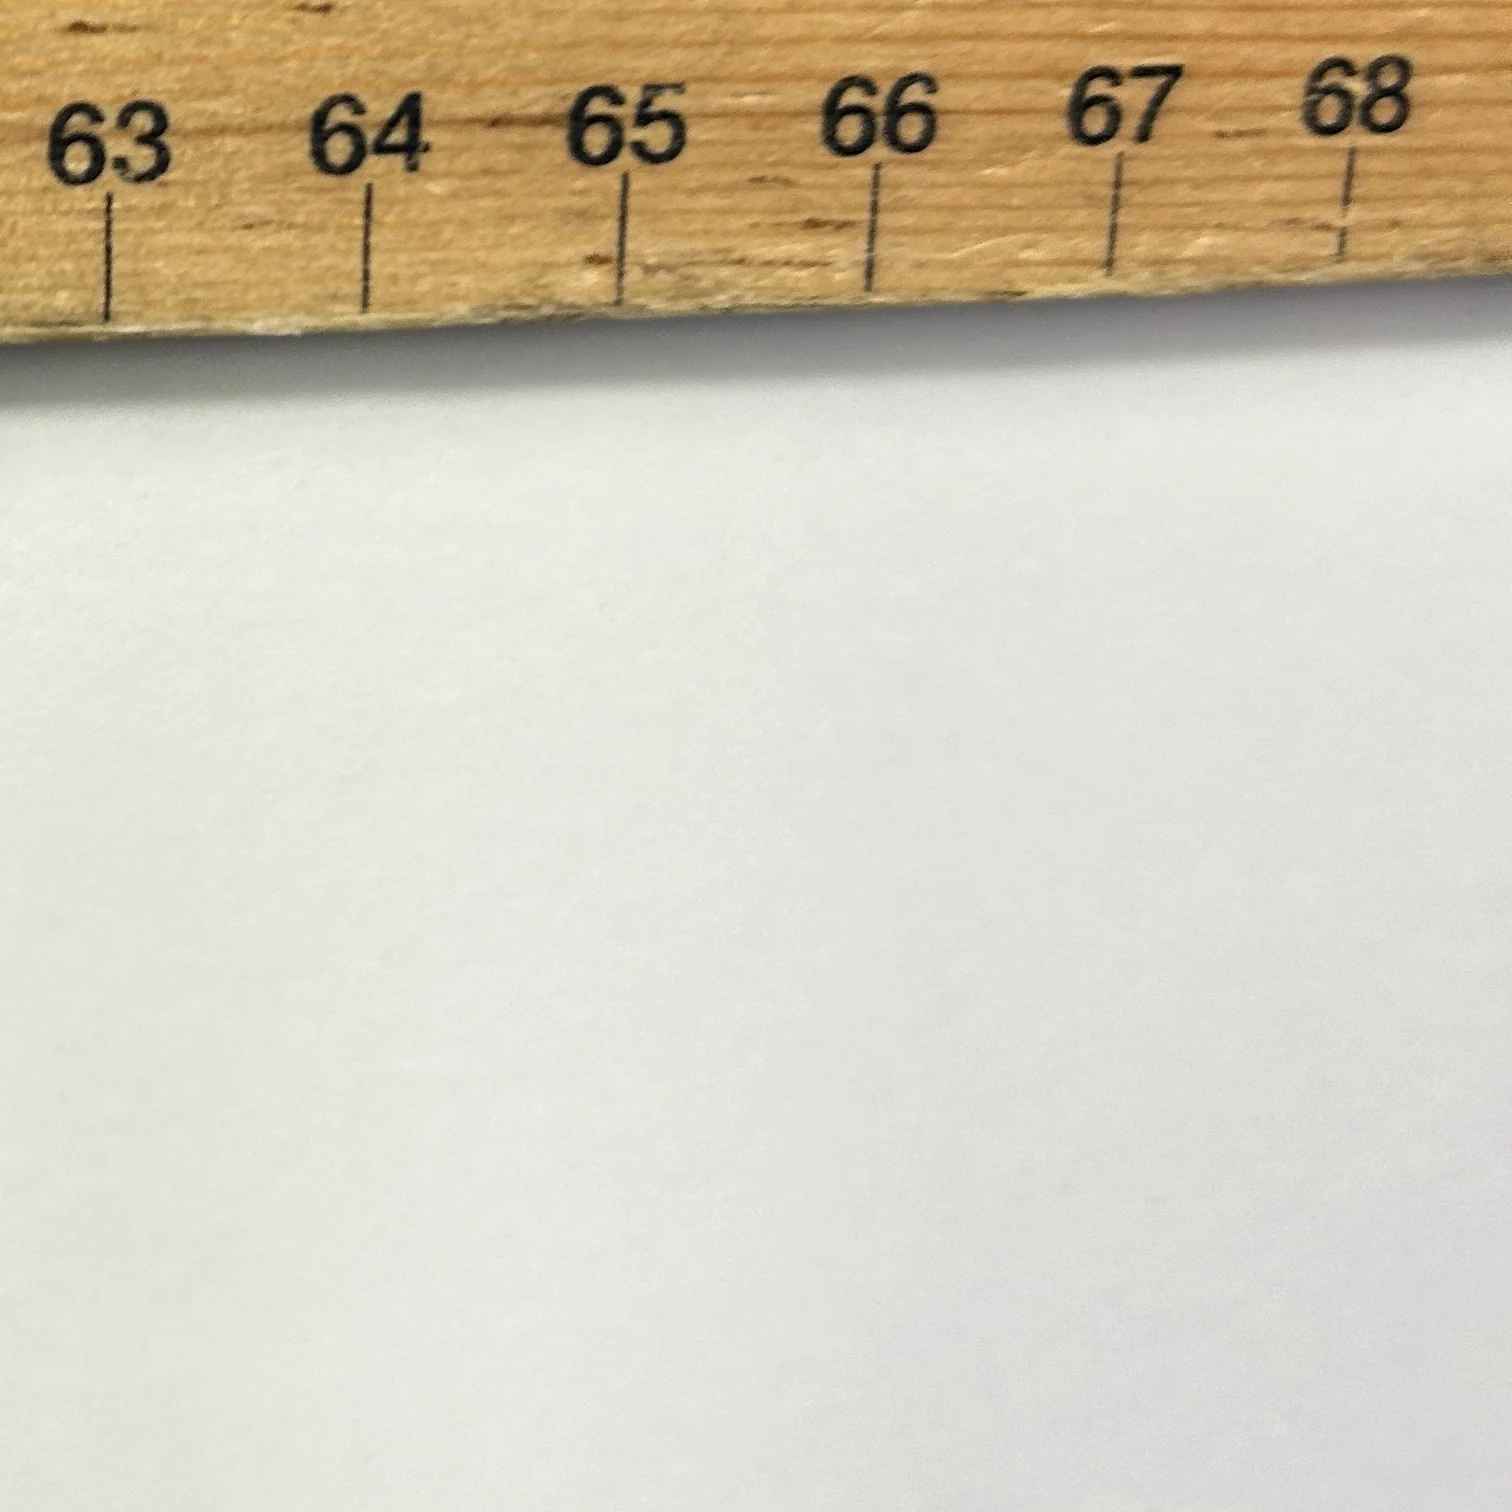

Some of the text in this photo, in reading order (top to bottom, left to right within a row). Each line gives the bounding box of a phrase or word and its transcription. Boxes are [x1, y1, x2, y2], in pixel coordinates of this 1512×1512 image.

[47, 99, 172, 186] 63
[307, 91, 432, 177] 64
[565, 81, 687, 168] 65
[819, 71, 940, 157] 66
[1065, 63, 1186, 147] 67
[1301, 54, 1414, 137] 68
